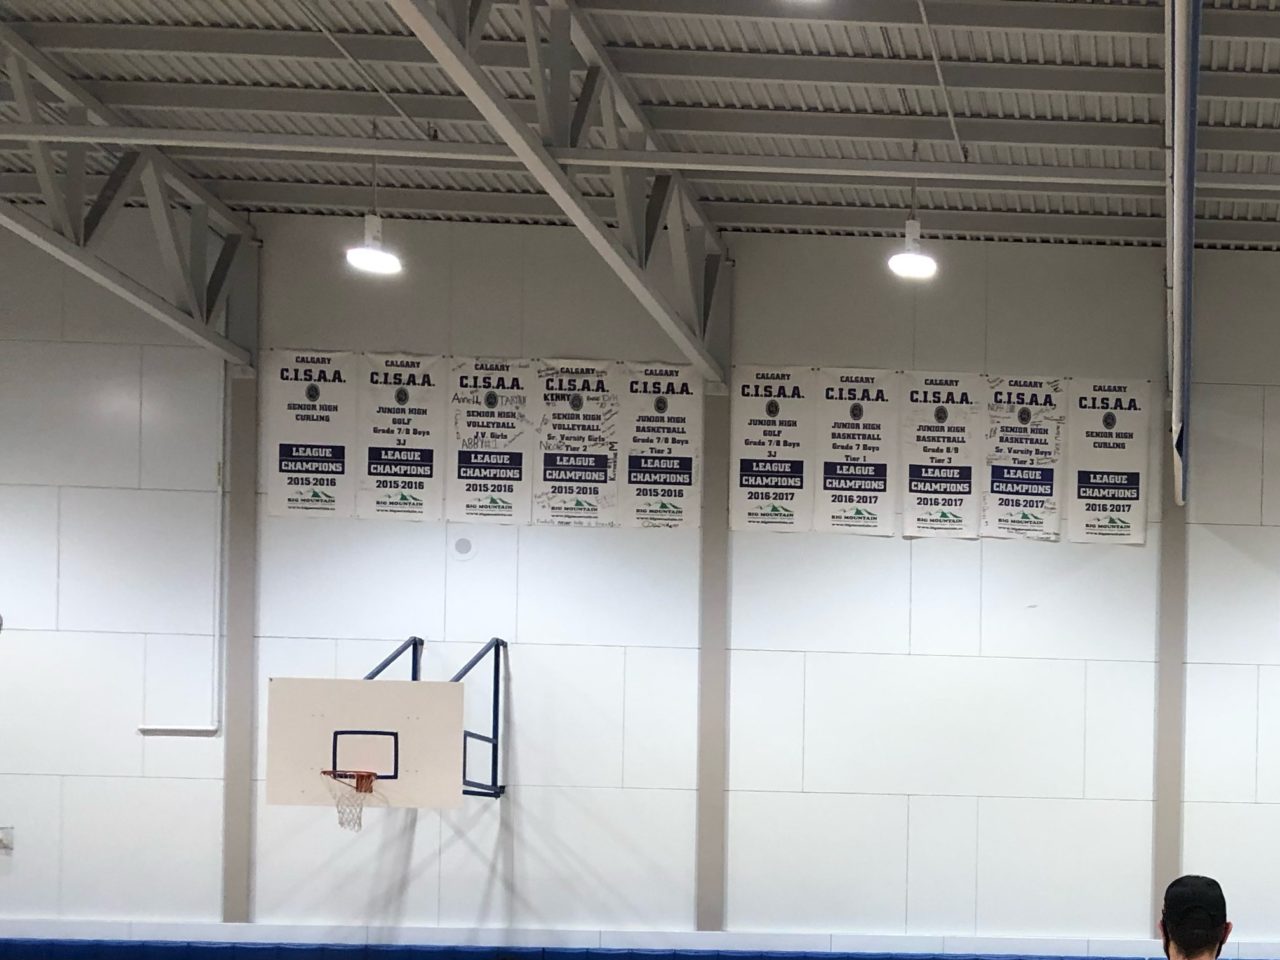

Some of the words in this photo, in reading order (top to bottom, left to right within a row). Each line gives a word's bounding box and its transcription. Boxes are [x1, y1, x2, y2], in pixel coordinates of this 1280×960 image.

[295, 356, 331, 364] CALGARY
[385, 360, 420, 368] CALGARY
[280, 368, 346, 383] C.I.S.A.A.
[560, 367, 595, 375] CALGARY
[370, 372, 435, 386] C.I.S.A.A.
[459, 376, 524, 390] C.I.S.A.A.
[840, 376, 875, 384] CALGARY
[546, 378, 609, 392] C.I.S.A.A.
[630, 381, 693, 395] C.I.S.A.A.
[1009, 380, 1043, 388] CALGARY
[741, 384, 805, 399] C.I.S.A.A.
[825, 387, 888, 402] C.I.S.A.A.
[910, 391, 973, 405] C.I.S.A.A.
[994, 392, 1056, 406] C.I.S.A.A.
[287, 403, 317, 411] SENIOR
[1079, 397, 1141, 411] C.I.S.A.A.
[667, 416, 686, 424] HIGH
[467, 421, 515, 429] VOLLEYBALL
[552, 423, 601, 431] VOLLEYBALL
[636, 426, 686, 434] BASKETBALL
[916, 435, 966, 443] BASKETBALL
[999, 437, 1048, 445] BASKETBALL
[292, 448, 332, 457] LEAGUE
[381, 451, 421, 460] LEAGUE
[471, 454, 509, 463] LEAGUE
[557, 457, 595, 465] LEAGUE
[282, 462, 342, 472] CHAMPIONS
[641, 459, 679, 468] LEAGUE
[753, 462, 791, 471] LEAGUE
[371, 465, 430, 475] CHAMPIONS
[460, 468, 519, 478] CHAMPIONS
[837, 465, 875, 475] LEAGUE
[922, 469, 959, 478] LEAGUE
[1004, 470, 1041, 479] LEAGUE
[546, 470, 605, 480] CHAMPIONS
[631, 473, 689, 483] CHAMPIONS
[1090, 474, 1127, 483] LEAGUE
[287, 477, 336, 486] 2015-2016
[376, 480, 424, 489] 2015-2016
[742, 476, 800, 486] CHAMPIONS
[826, 479, 884, 489] CHAMPIONS
[466, 483, 513, 493] 2015-2016
[551, 486, 599, 495] 2015-2016
[912, 482, 969, 492] CHAMPIONS
[993, 483, 1051, 493] CHAMPIONS
[636, 488, 683, 497] 2015-2016
[748, 491, 794, 501] 2016-2017
[1080, 488, 1137, 497] CHAMPIONS
[831, 495, 878, 504] 2016-2017
[917, 498, 963, 506] 2016-2017
[999, 499, 1045, 508] 2016-2017
[1085, 503, 1131, 512] 2016-2017
